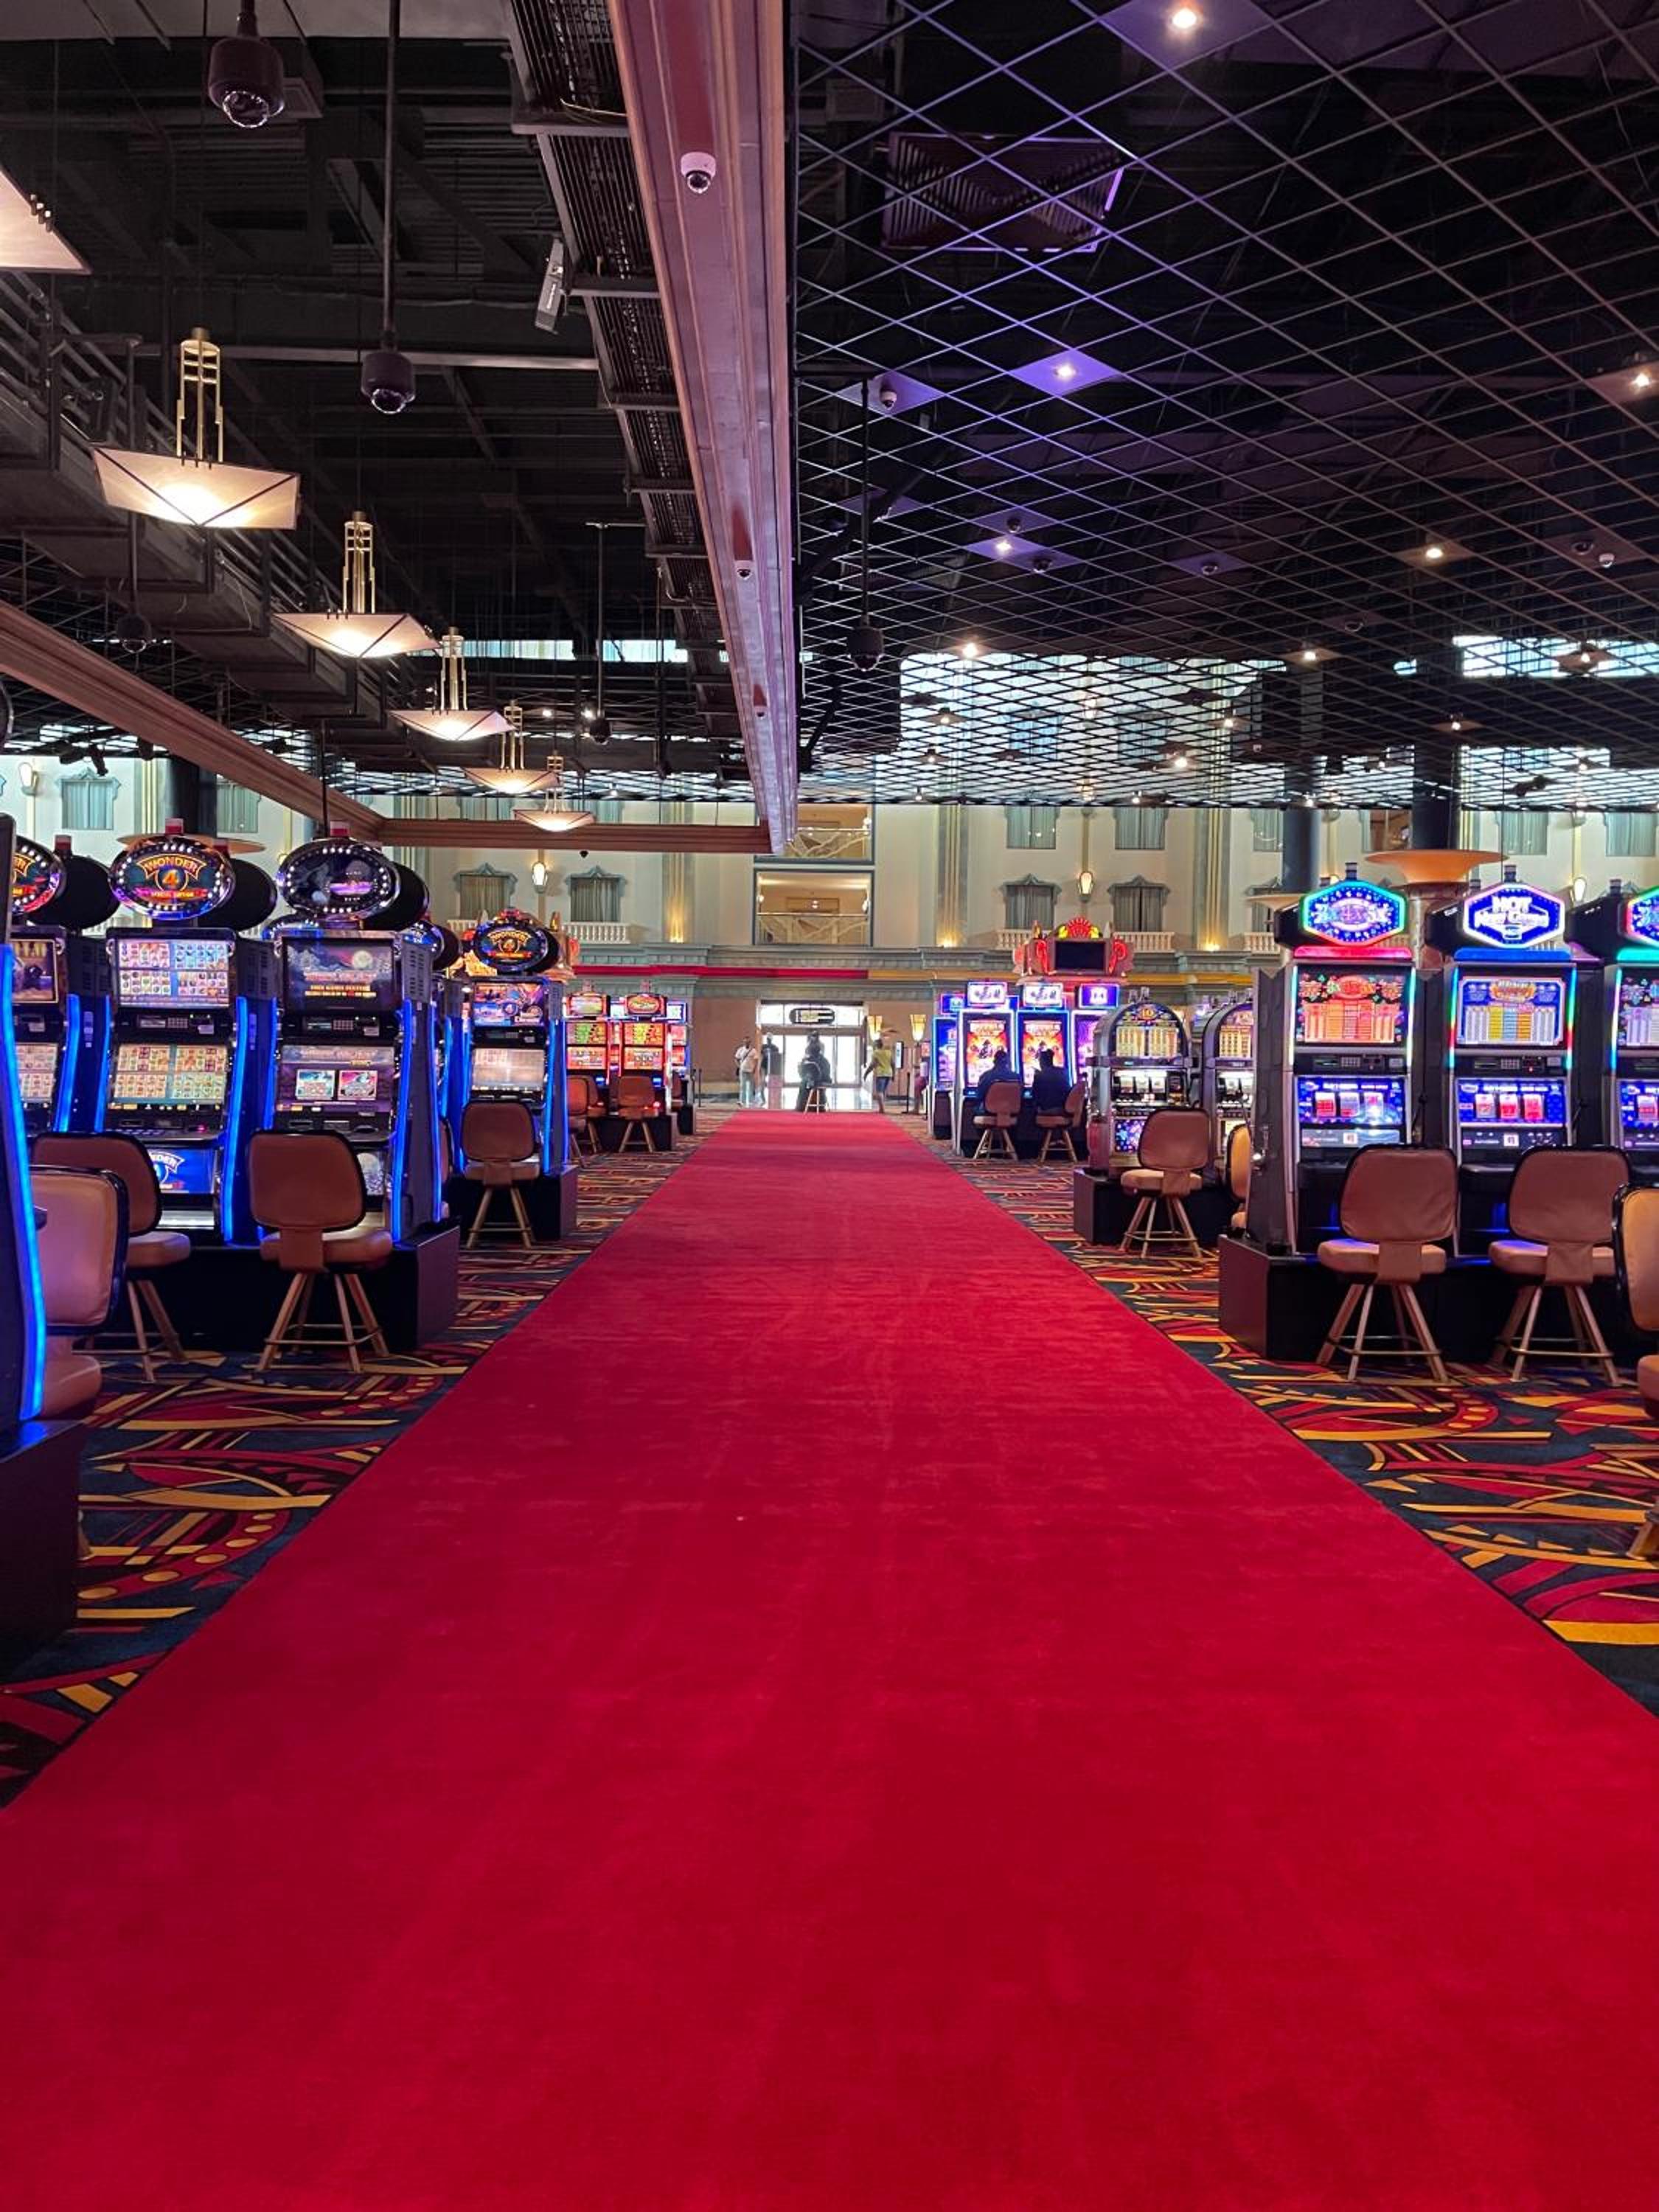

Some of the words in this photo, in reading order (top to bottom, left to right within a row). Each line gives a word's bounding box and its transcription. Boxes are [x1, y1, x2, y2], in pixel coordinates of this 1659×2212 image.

[144, 856, 198, 873] WONDER
[162, 869, 179, 888] 4
[1492, 896, 1532, 914] HOT
